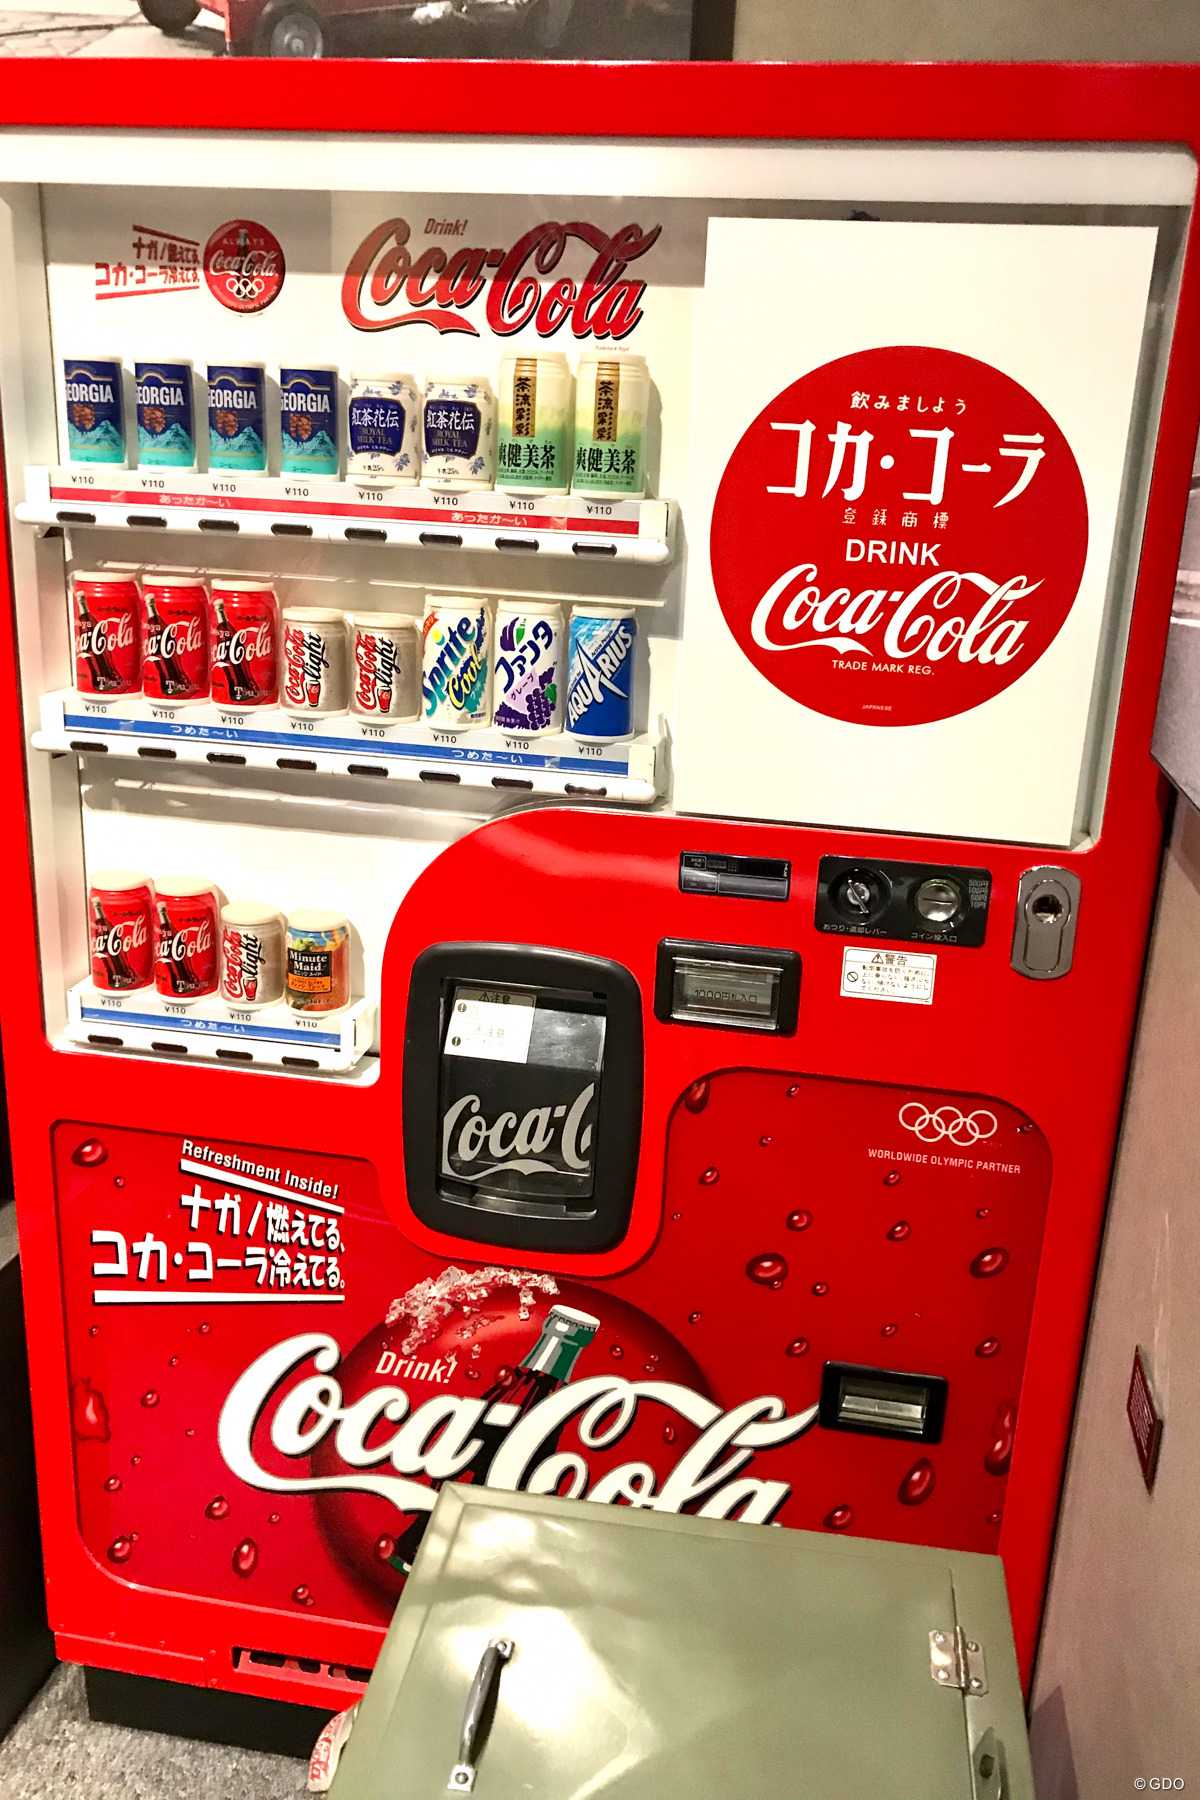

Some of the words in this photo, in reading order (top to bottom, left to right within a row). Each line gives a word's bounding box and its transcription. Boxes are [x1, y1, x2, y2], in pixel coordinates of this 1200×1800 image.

[424, 217, 468, 236] Drink!
[208, 250, 281, 278] Coca-Cola
[341, 217, 662, 341] Coca-Cola
[66, 383, 114, 403] EORGIA
[136, 385, 185, 406] EORGIA
[515, 377, 532, 436] 茶流彩彩
[596, 380, 615, 441] 茶流彩彩
[352, 407, 399, 429] 紅茶花伝
[426, 409, 475, 431] 紅茶花伝
[453, 439, 468, 448] TEA
[576, 447, 636, 475] 爽健美茶
[766, 419, 1046, 508] コカ・コーラ
[71, 475, 95, 485] ¥110
[141, 479, 165, 489] ¥110
[212, 483, 237, 493] ¥110
[284, 487, 310, 497] ¥110
[358, 491, 383, 501] ¥110
[433, 496, 459, 506] ¥110
[509, 501, 535, 511] ¥110
[586, 505, 612, 516] ¥110
[845, 538, 941, 567] DRINK
[750, 563, 1046, 666] Coca-Cola
[75, 613, 134, 658] ca-Cola
[143, 617, 203, 663] ca-Cola
[211, 622, 272, 670] ca-Cola
[285, 625, 306, 704] Coca-Cola
[301, 631, 329, 681] light
[495, 620, 553, 694] ファンタ
[355, 630, 377, 710] Coca-Cola
[373, 637, 401, 688] light
[422, 617, 476, 718] Sprite
[449, 641, 482, 711] Cool
[567, 625, 632, 728] AQUARIUS
[832, 659, 868, 672] TRADE
[871, 662, 904, 674] MARK
[908, 664, 935, 676] REG.
[85, 705, 107, 714] ¥110
[152, 711, 175, 720] ¥110
[861, 703, 893, 712] JAPANESE
[221, 716, 244, 725] ¥110
[291, 722, 314, 731] ¥110
[362, 728, 385, 737] ¥110
[433, 733, 457, 743] ¥110
[505, 740, 530, 750] ¥110
[577, 746, 603, 756] ¥110
[91, 913, 148, 959] ca-Cola
[155, 920, 211, 963] ca-Cola
[239, 933, 266, 976] light
[289, 950, 328, 963] Minute
[884, 953, 908, 966] 警告
[294, 961, 322, 971] Maid
[101, 999, 122, 1008] ¥110
[165, 1005, 187, 1015] ¥110
[230, 1012, 252, 1022] ¥110
[295, 1019, 318, 1029] ¥110
[182, 1139, 281, 1184] Refreshment
[284, 1169, 340, 1200] Inside!
[867, 1148, 928, 1165] WORLDWIDE
[930, 1155, 974, 1170] OLYMPIC
[976, 1160, 1021, 1175] PARTNER
[92, 1229, 345, 1290] コカ・コーラ冷えてる。
[375, 1350, 457, 1385] Drink!
[218, 1332, 820, 1527] Coca-Cola
